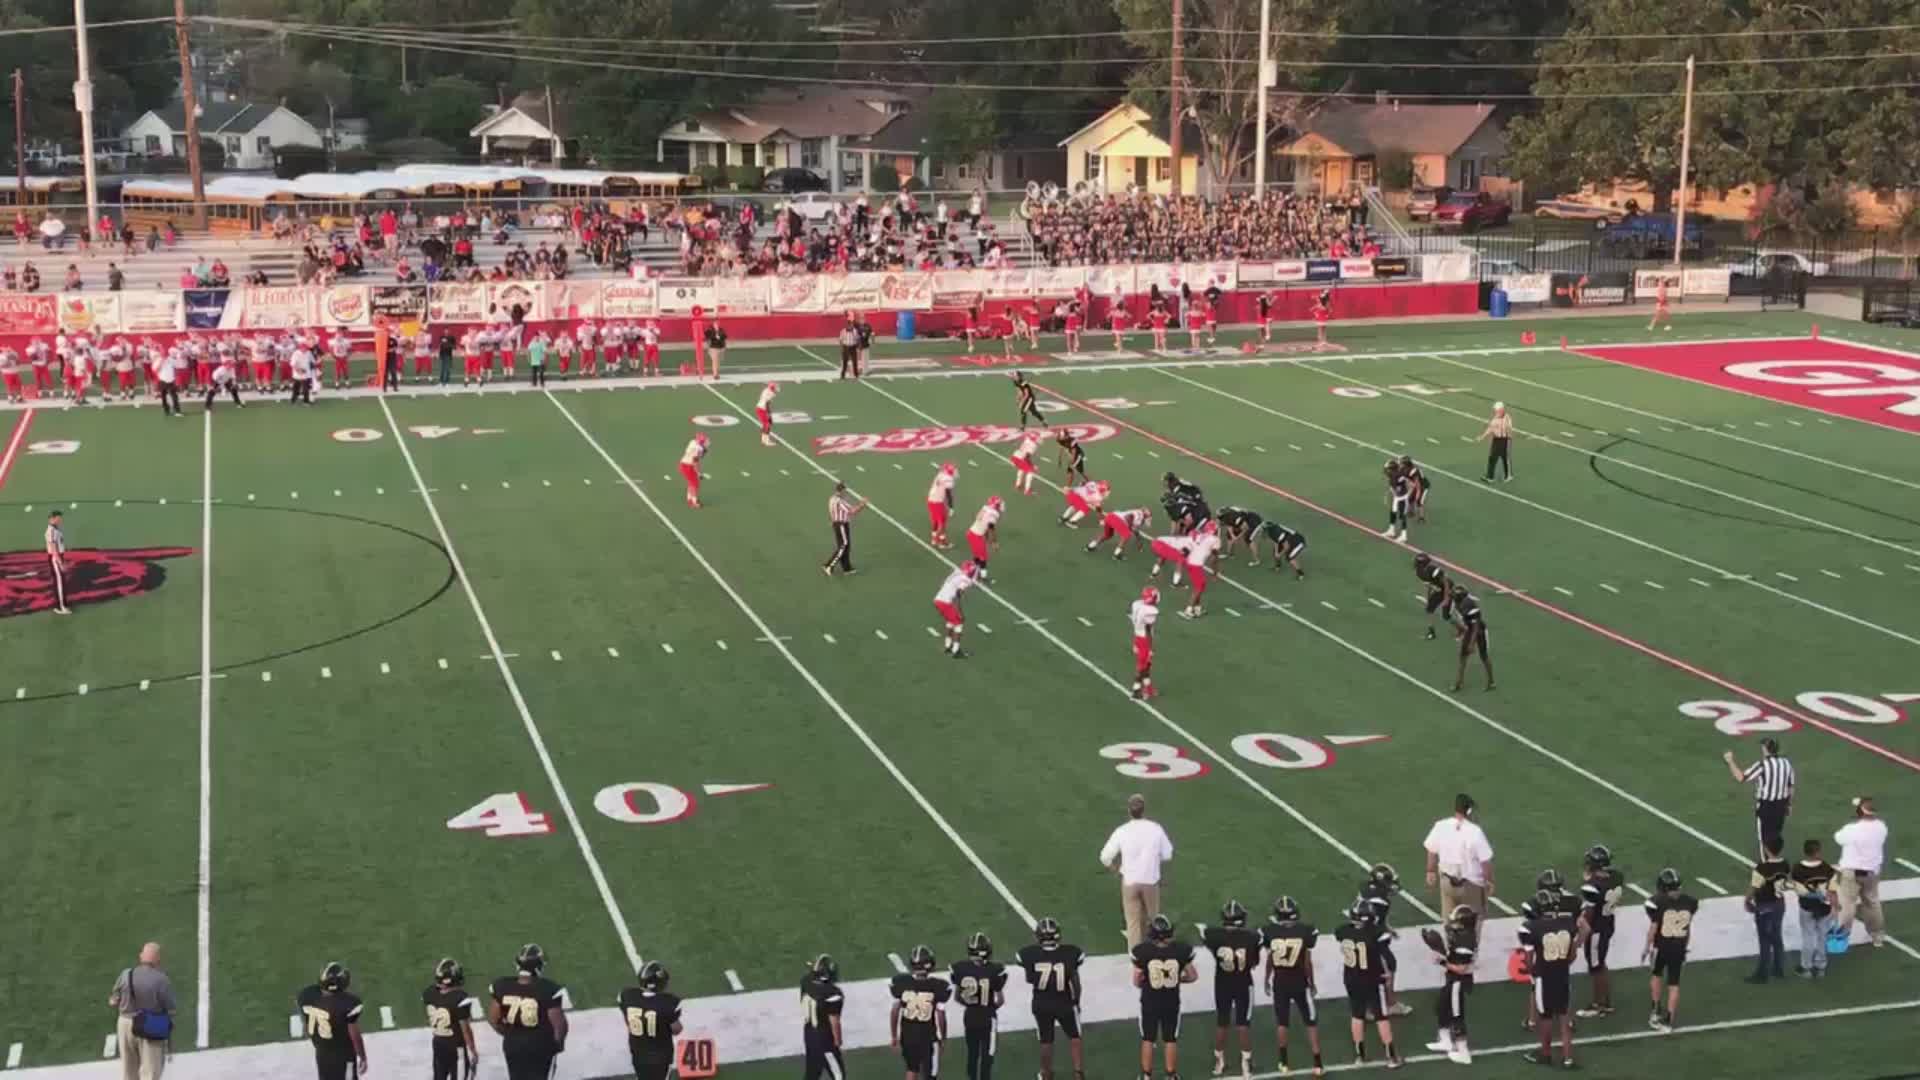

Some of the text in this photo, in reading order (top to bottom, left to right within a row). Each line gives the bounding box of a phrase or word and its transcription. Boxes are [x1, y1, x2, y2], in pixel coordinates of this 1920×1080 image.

[1216, 946, 1246, 972] 31
[1270, 938, 1303, 967] 27
[960, 975, 991, 1006] 21
[1034, 962, 1065, 991] 71
[682, 1040, 713, 1071] 40
